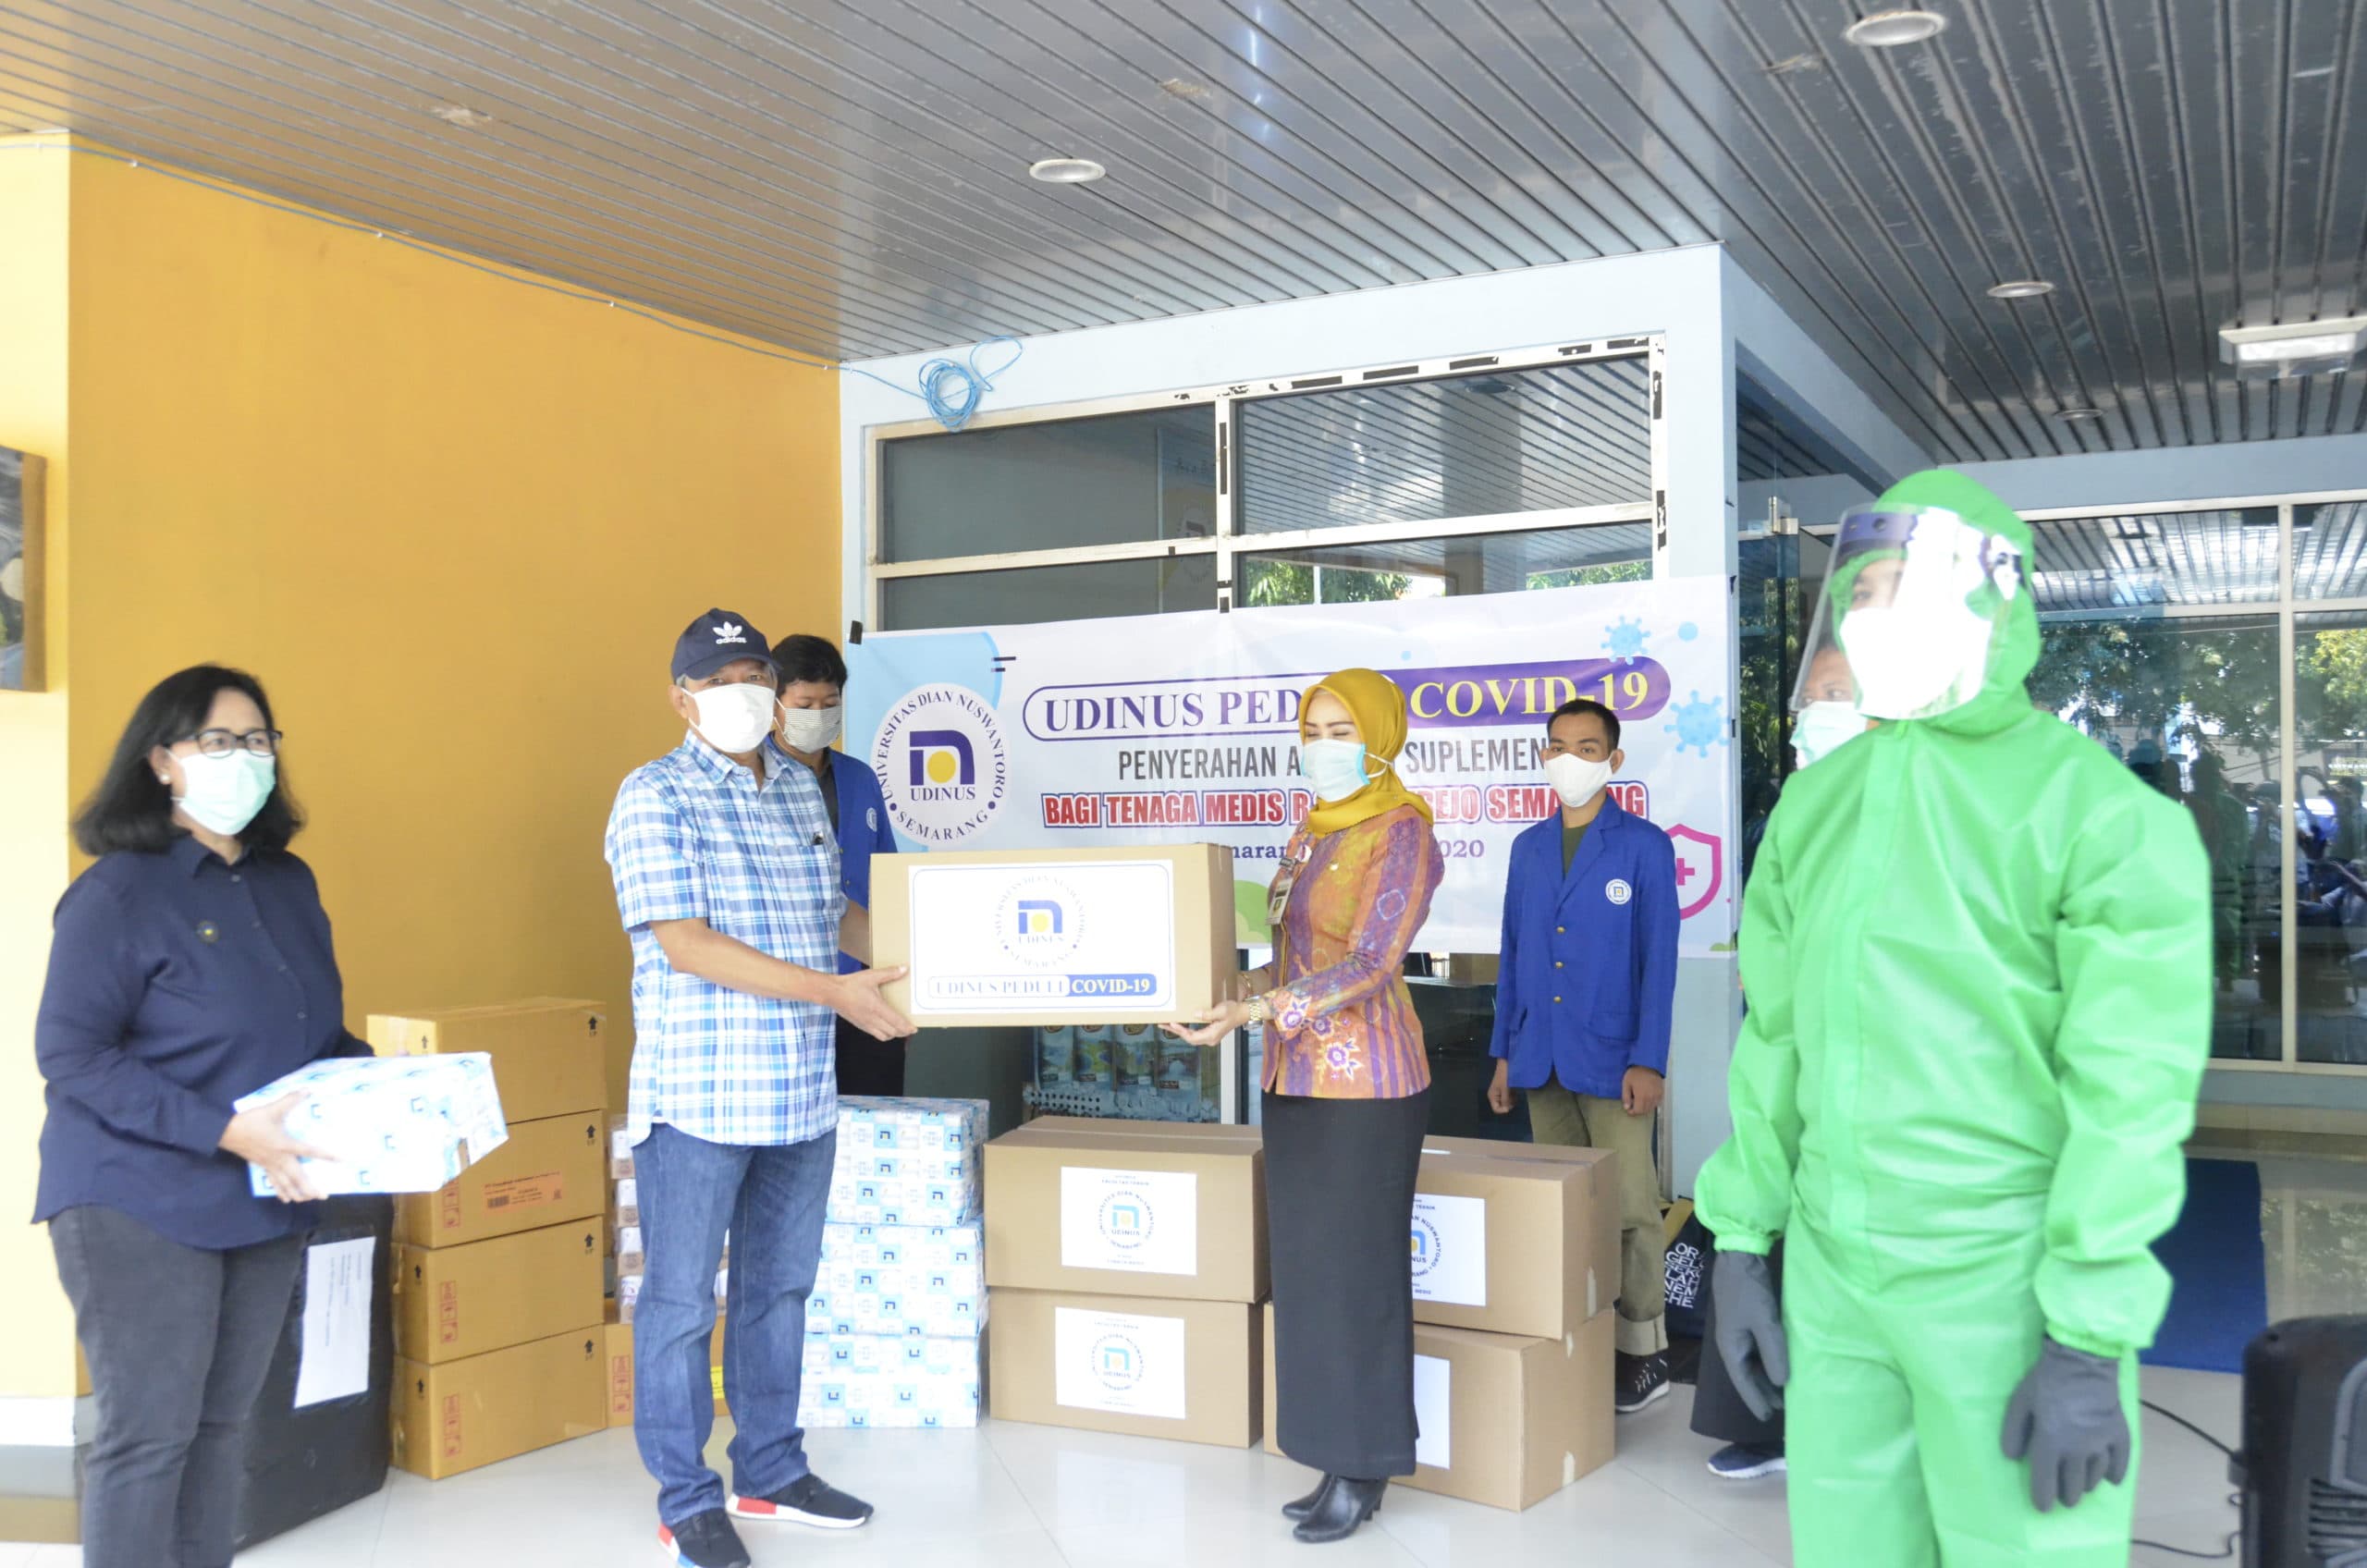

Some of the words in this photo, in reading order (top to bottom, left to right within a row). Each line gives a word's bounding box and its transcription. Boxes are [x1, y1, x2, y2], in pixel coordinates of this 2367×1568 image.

[1045, 692, 1204, 732] UDINUS
[1218, 688, 1302, 726] PED
[1410, 671, 1649, 718] COVID-19
[877, 700, 917, 802] UNIVERSITAS
[917, 690, 953, 706] DIAN
[956, 693, 1006, 799] NUSWANTORO
[1118, 746, 1277, 780] PENYERAHAN
[910, 787, 976, 802] UDINUS
[1044, 795, 1099, 825] BAGI
[1105, 793, 1200, 824] TENAGA
[1202, 791, 1284, 822] MEDIS
[1488, 784, 1645, 820] SEMANG
[896, 809, 989, 840] SEMARANG
[1073, 978, 1150, 994] COVID-19
